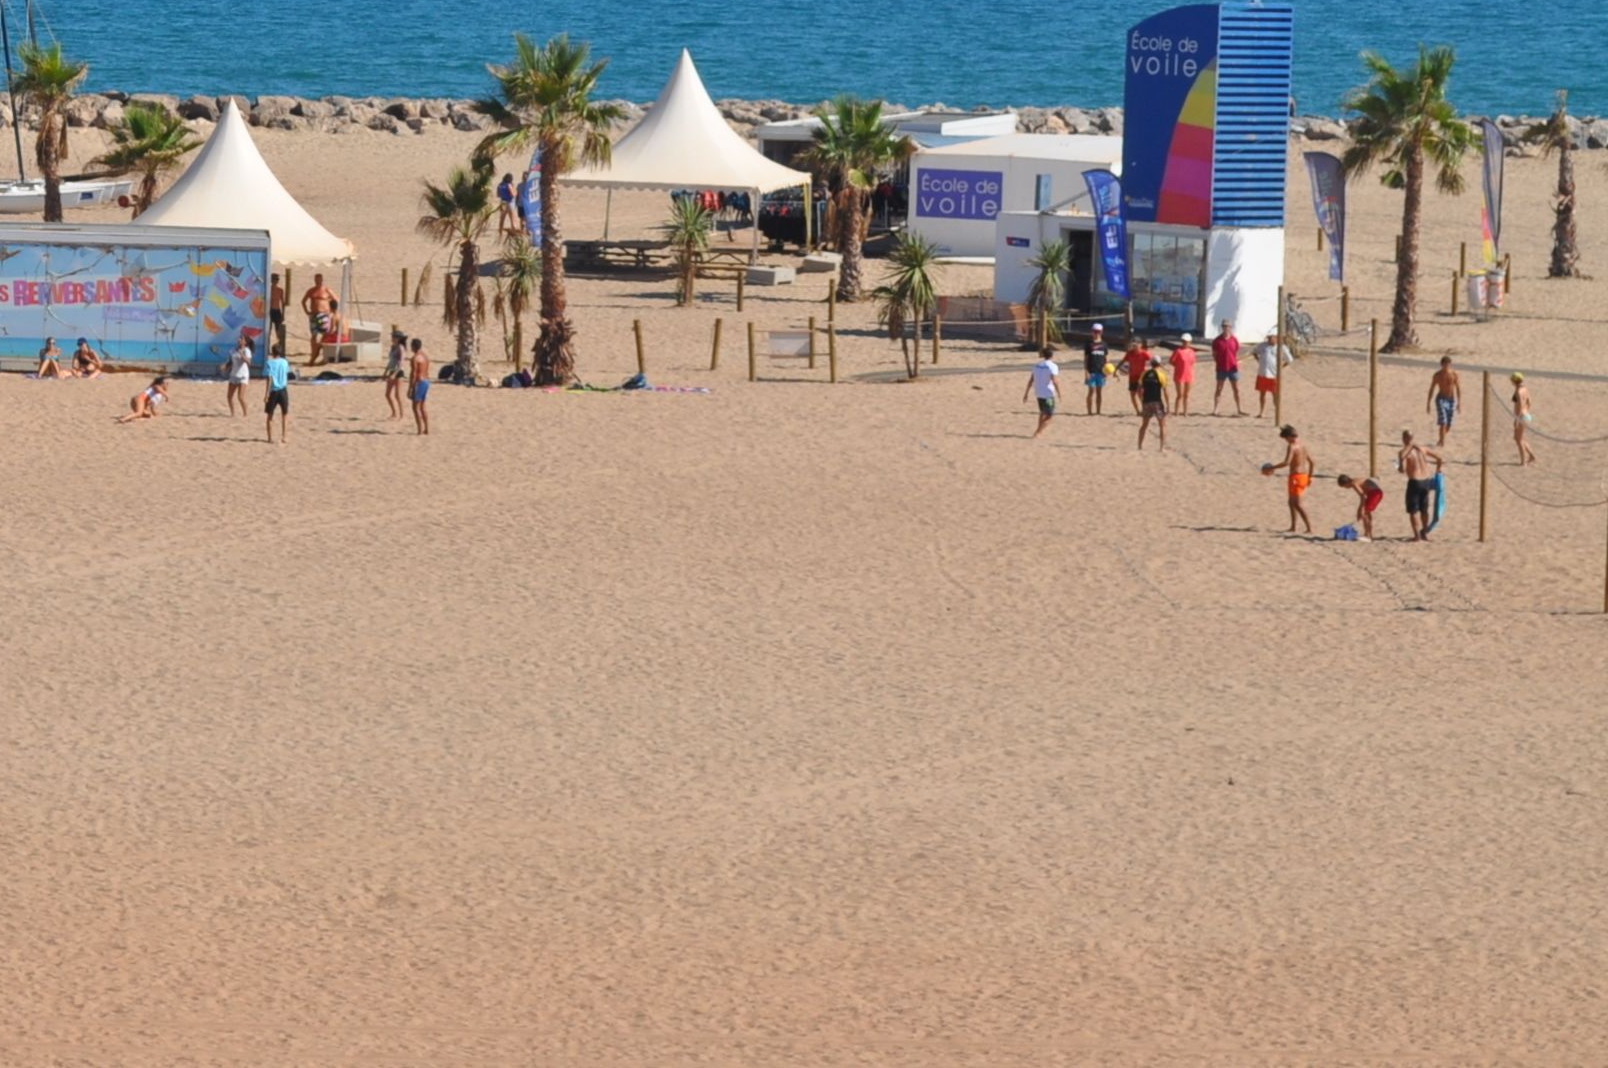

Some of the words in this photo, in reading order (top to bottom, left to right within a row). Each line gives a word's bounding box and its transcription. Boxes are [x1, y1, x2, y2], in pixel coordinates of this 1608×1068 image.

[1131, 30, 1172, 52] École
[1178, 37, 1199, 53] de
[1130, 53, 1198, 78] voile
[921, 173, 969, 193] École
[975, 180, 999, 195] de
[920, 194, 998, 217] voile
